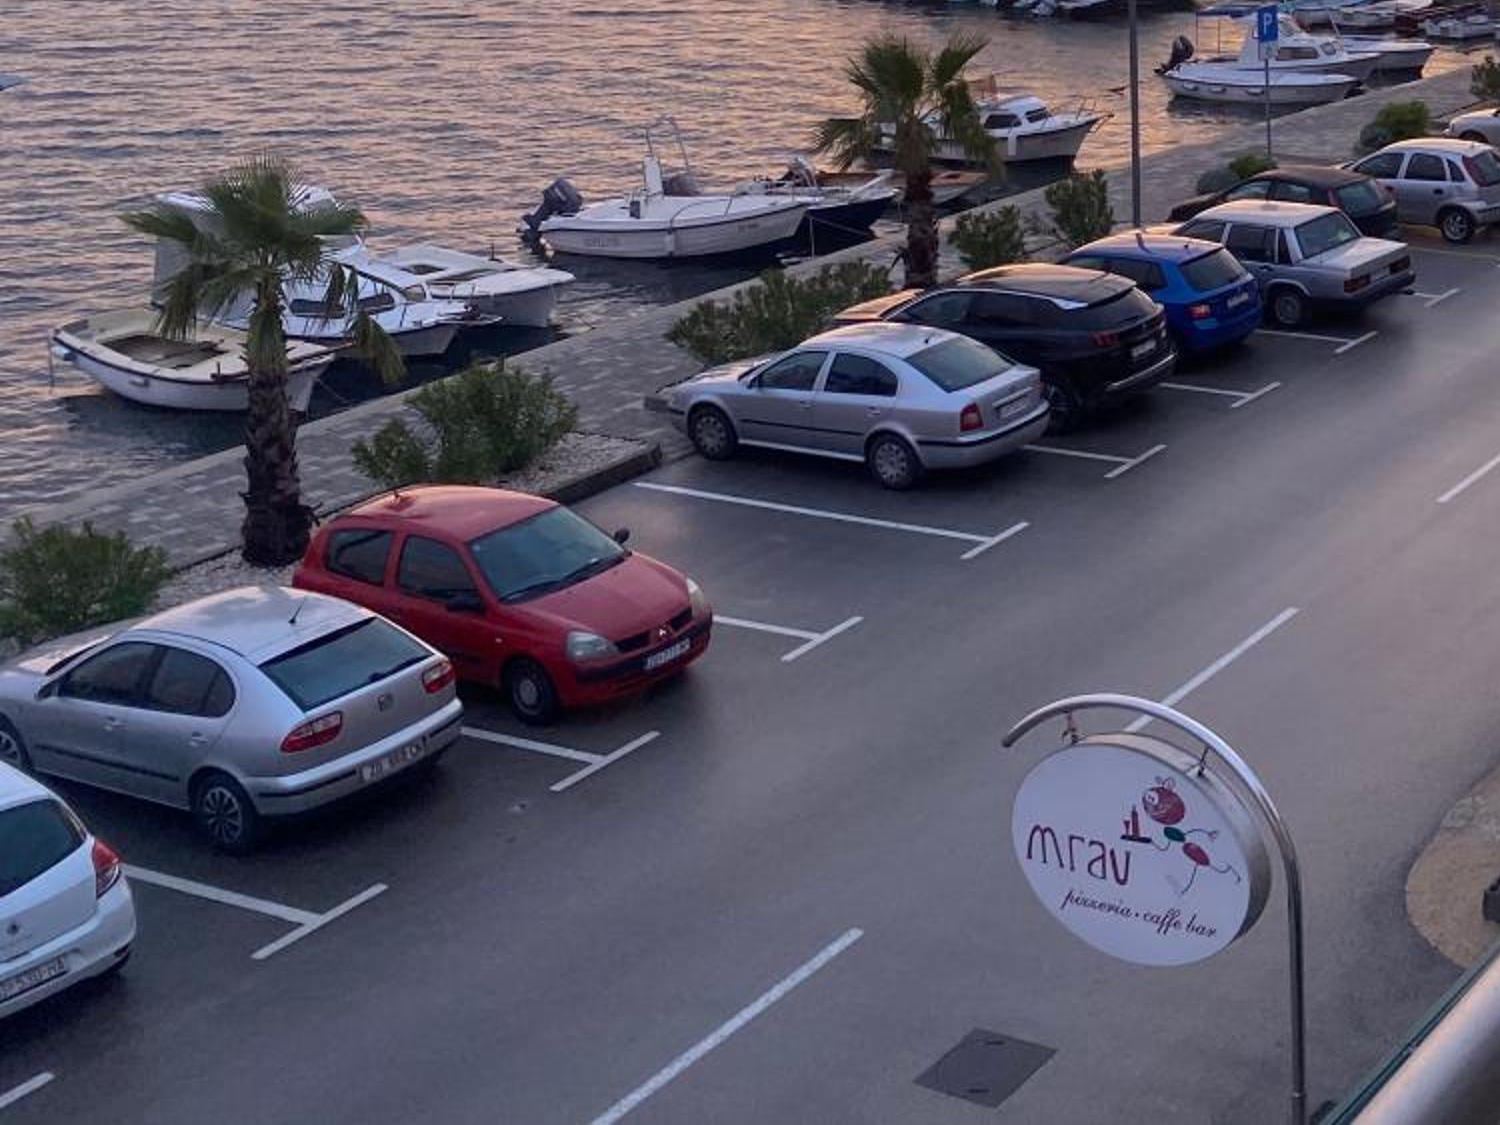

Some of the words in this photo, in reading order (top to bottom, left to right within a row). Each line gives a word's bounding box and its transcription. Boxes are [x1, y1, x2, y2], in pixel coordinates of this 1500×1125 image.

[1060, 889, 1133, 919] pizzeria
[1143, 908, 1183, 936] caffe
[1186, 914, 1217, 938] bar
